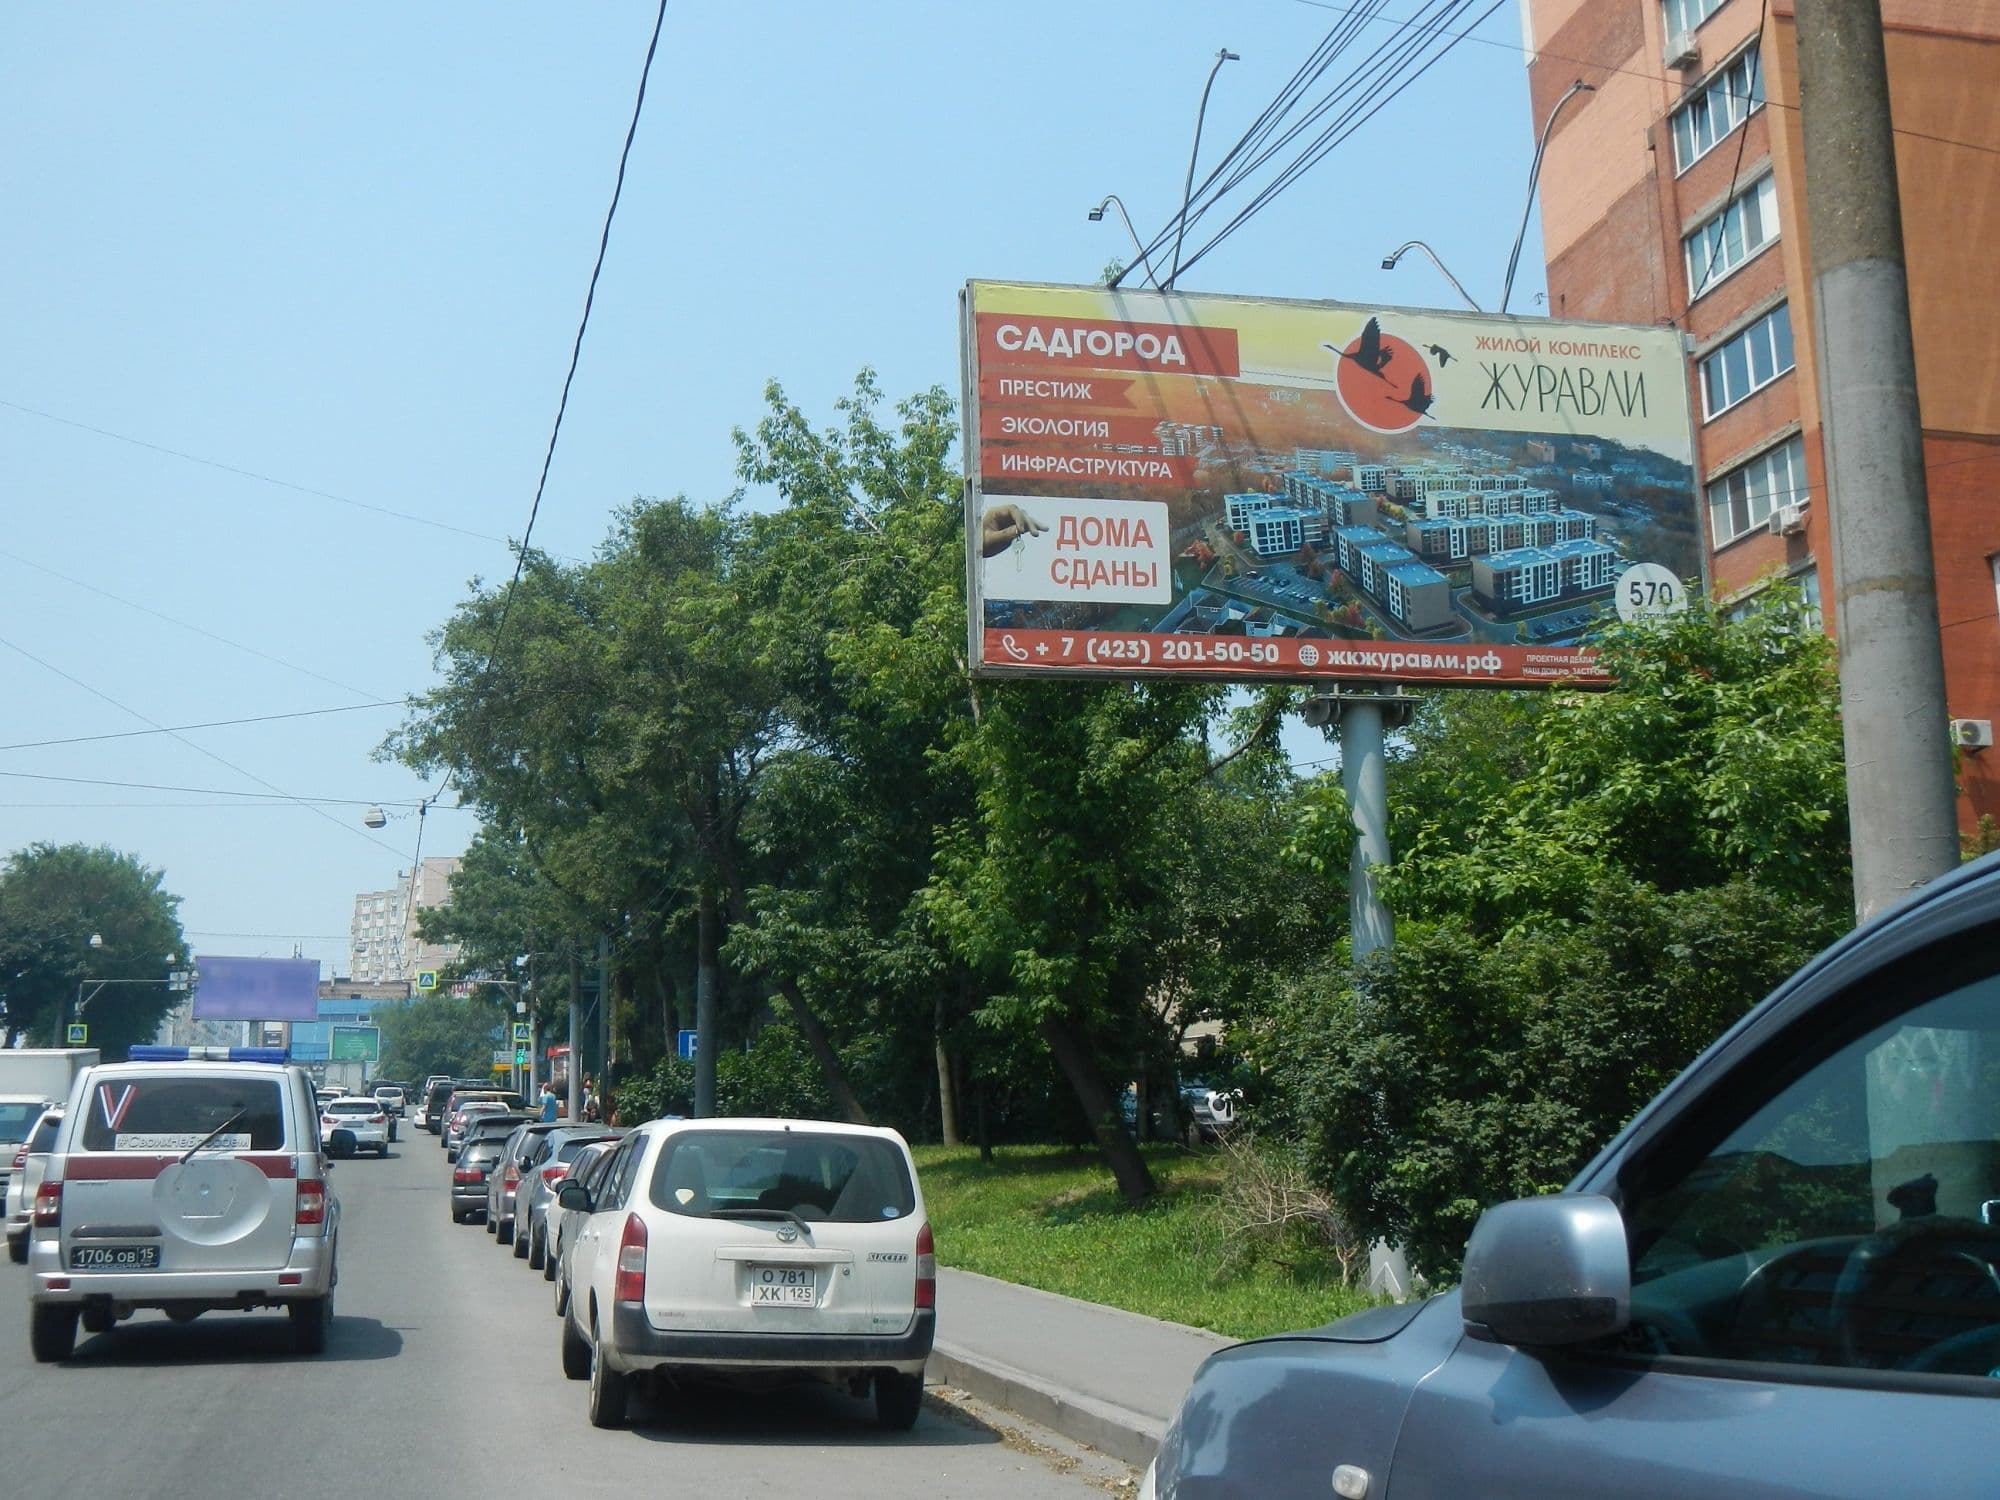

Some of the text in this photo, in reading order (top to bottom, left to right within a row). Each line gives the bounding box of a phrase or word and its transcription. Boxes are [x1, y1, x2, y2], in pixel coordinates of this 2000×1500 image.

[996, 324, 1186, 366] САДГОРОД
[1475, 335, 1642, 360] ЖИЛОЙ КОМПЛЕКС
[999, 379, 1093, 400] ПРЕСТИЖ
[1479, 361, 1647, 418] ЖУРАВЛИ
[1001, 416, 1109, 438] ЭКОЛОГИЯ
[1001, 454, 1173, 479] ИНФРАСТРУКТУРА
[1056, 515, 1154, 551] ДОМА
[1050, 557, 1158, 590] СДАНЫ
[1630, 581, 1673, 606] 570
[1061, 637, 1074, 657] 7
[1086, 638, 1151, 664] (423)
[1162, 640, 1279, 663] 201-50-50
[1326, 650, 1502, 675] жкжуравли.рф
[77, 1247, 154, 1263] 1706 ОВ 15
[779, 1270, 806, 1284] 781
[759, 1286, 811, 1301] ХК 125
